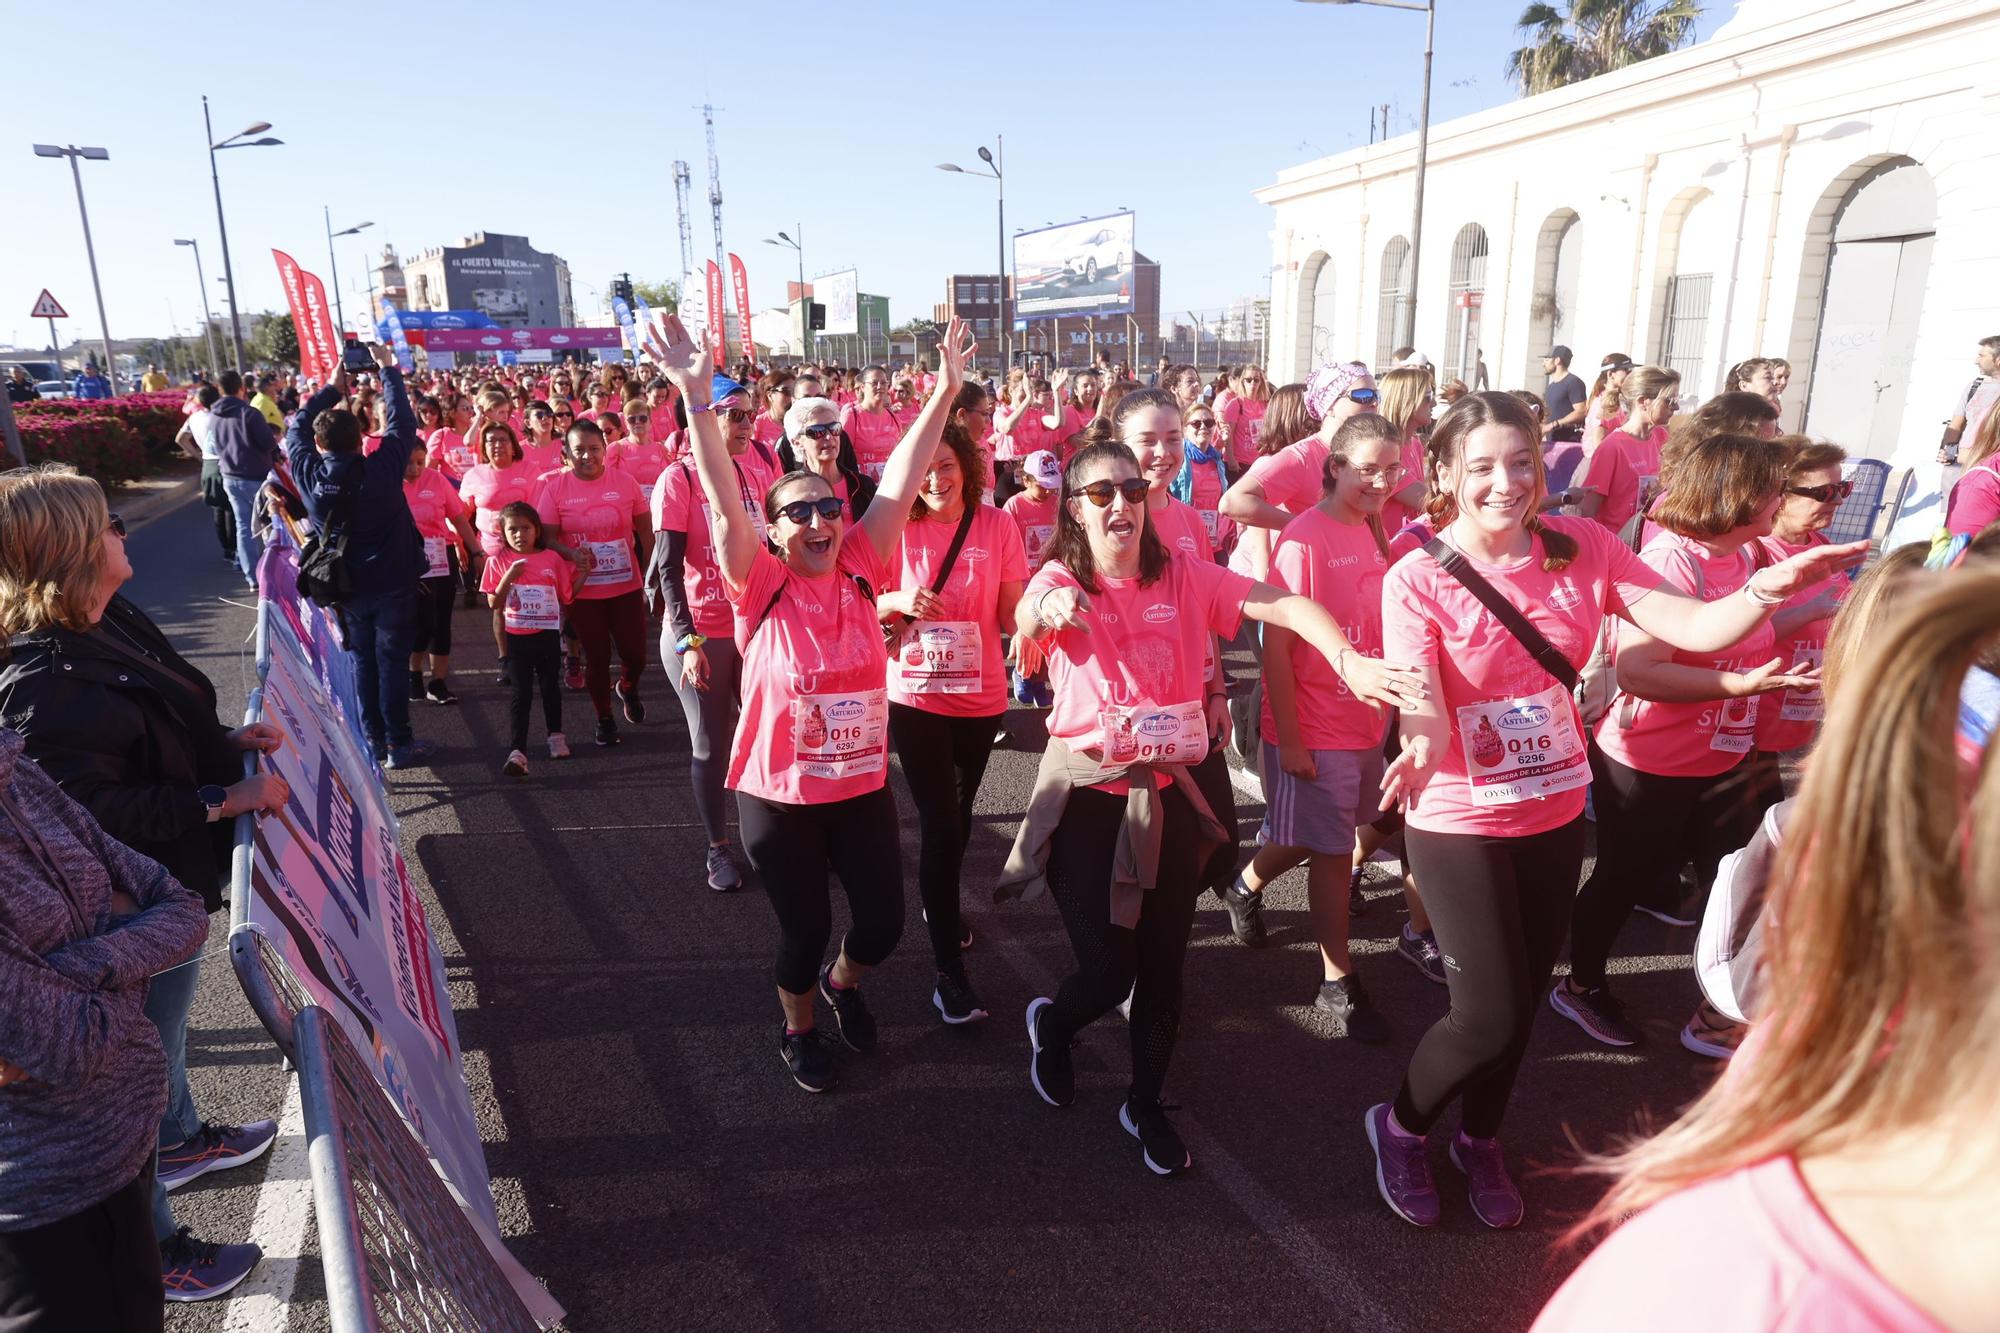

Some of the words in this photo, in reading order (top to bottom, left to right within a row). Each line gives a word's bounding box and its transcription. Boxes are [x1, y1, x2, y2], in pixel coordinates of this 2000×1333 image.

[461, 257, 490, 268] PUERTO
[1328, 555, 1358, 569] OYSHO
[1702, 585, 1734, 598] OYSHO
[927, 651, 954, 661] 016
[829, 707, 863, 717] ASTURIANA
[1501, 712, 1548, 727] ASTURIANA
[831, 727, 861, 740] 016
[1141, 723, 1178, 731] ASTURIANA
[836, 741, 855, 751] 6292
[1141, 743, 1176, 757] 016
[1508, 735, 1551, 753] 016
[1518, 753, 1545, 764] 6296
[804, 763, 835, 773] OYSHO
[1485, 771, 1519, 783] CARRERA
[1519, 769, 1530, 777] DE
[1531, 767, 1541, 775] LA
[1543, 763, 1565, 773] MUJER
[1551, 770, 1586, 785] Santander
[1484, 785, 1522, 799] OYSHO
